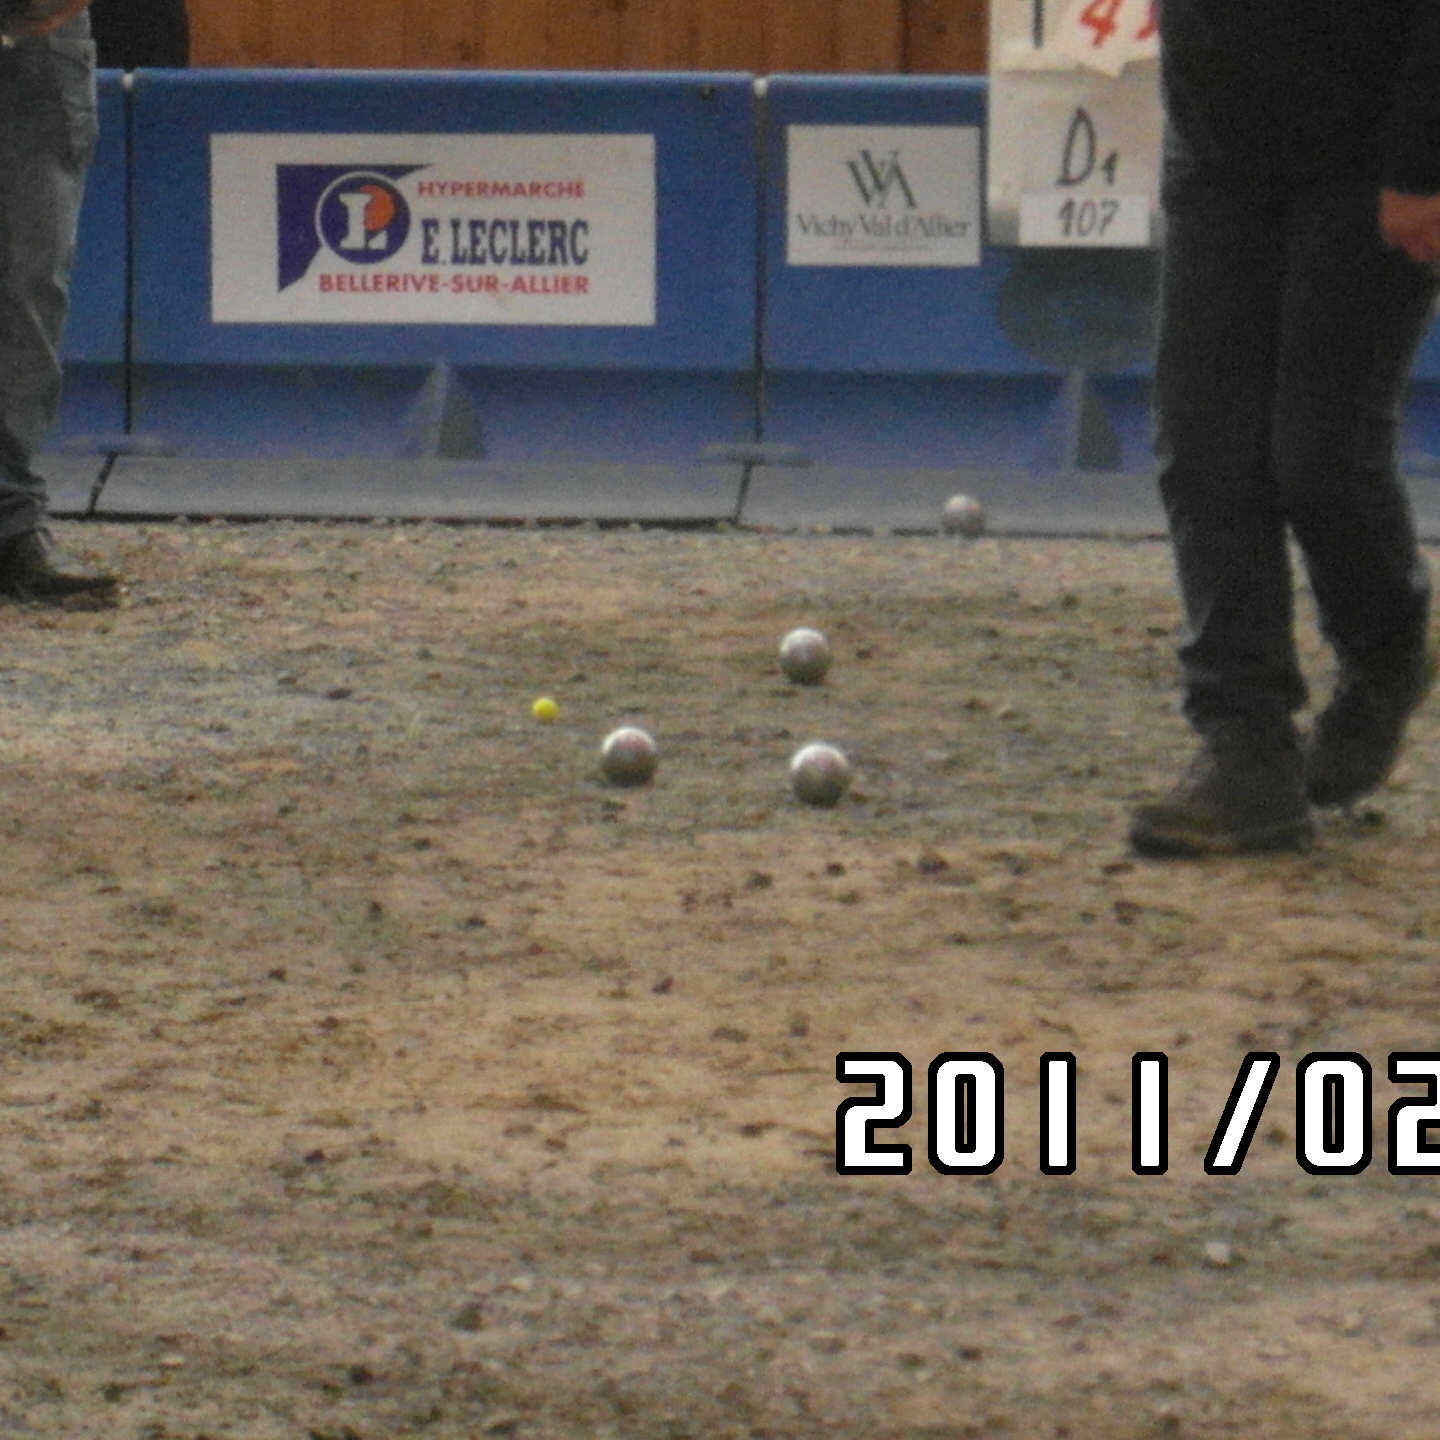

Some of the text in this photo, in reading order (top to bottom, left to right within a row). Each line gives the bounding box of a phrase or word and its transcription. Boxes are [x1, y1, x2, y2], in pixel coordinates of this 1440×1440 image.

[796, 211, 972, 238] Vichy Val d'Allier
[1059, 198, 1120, 239] 107
[419, 218, 590, 267] E.LECLERC
[318, 273, 590, 296] BELLERIVE-SUR-ALLIER
